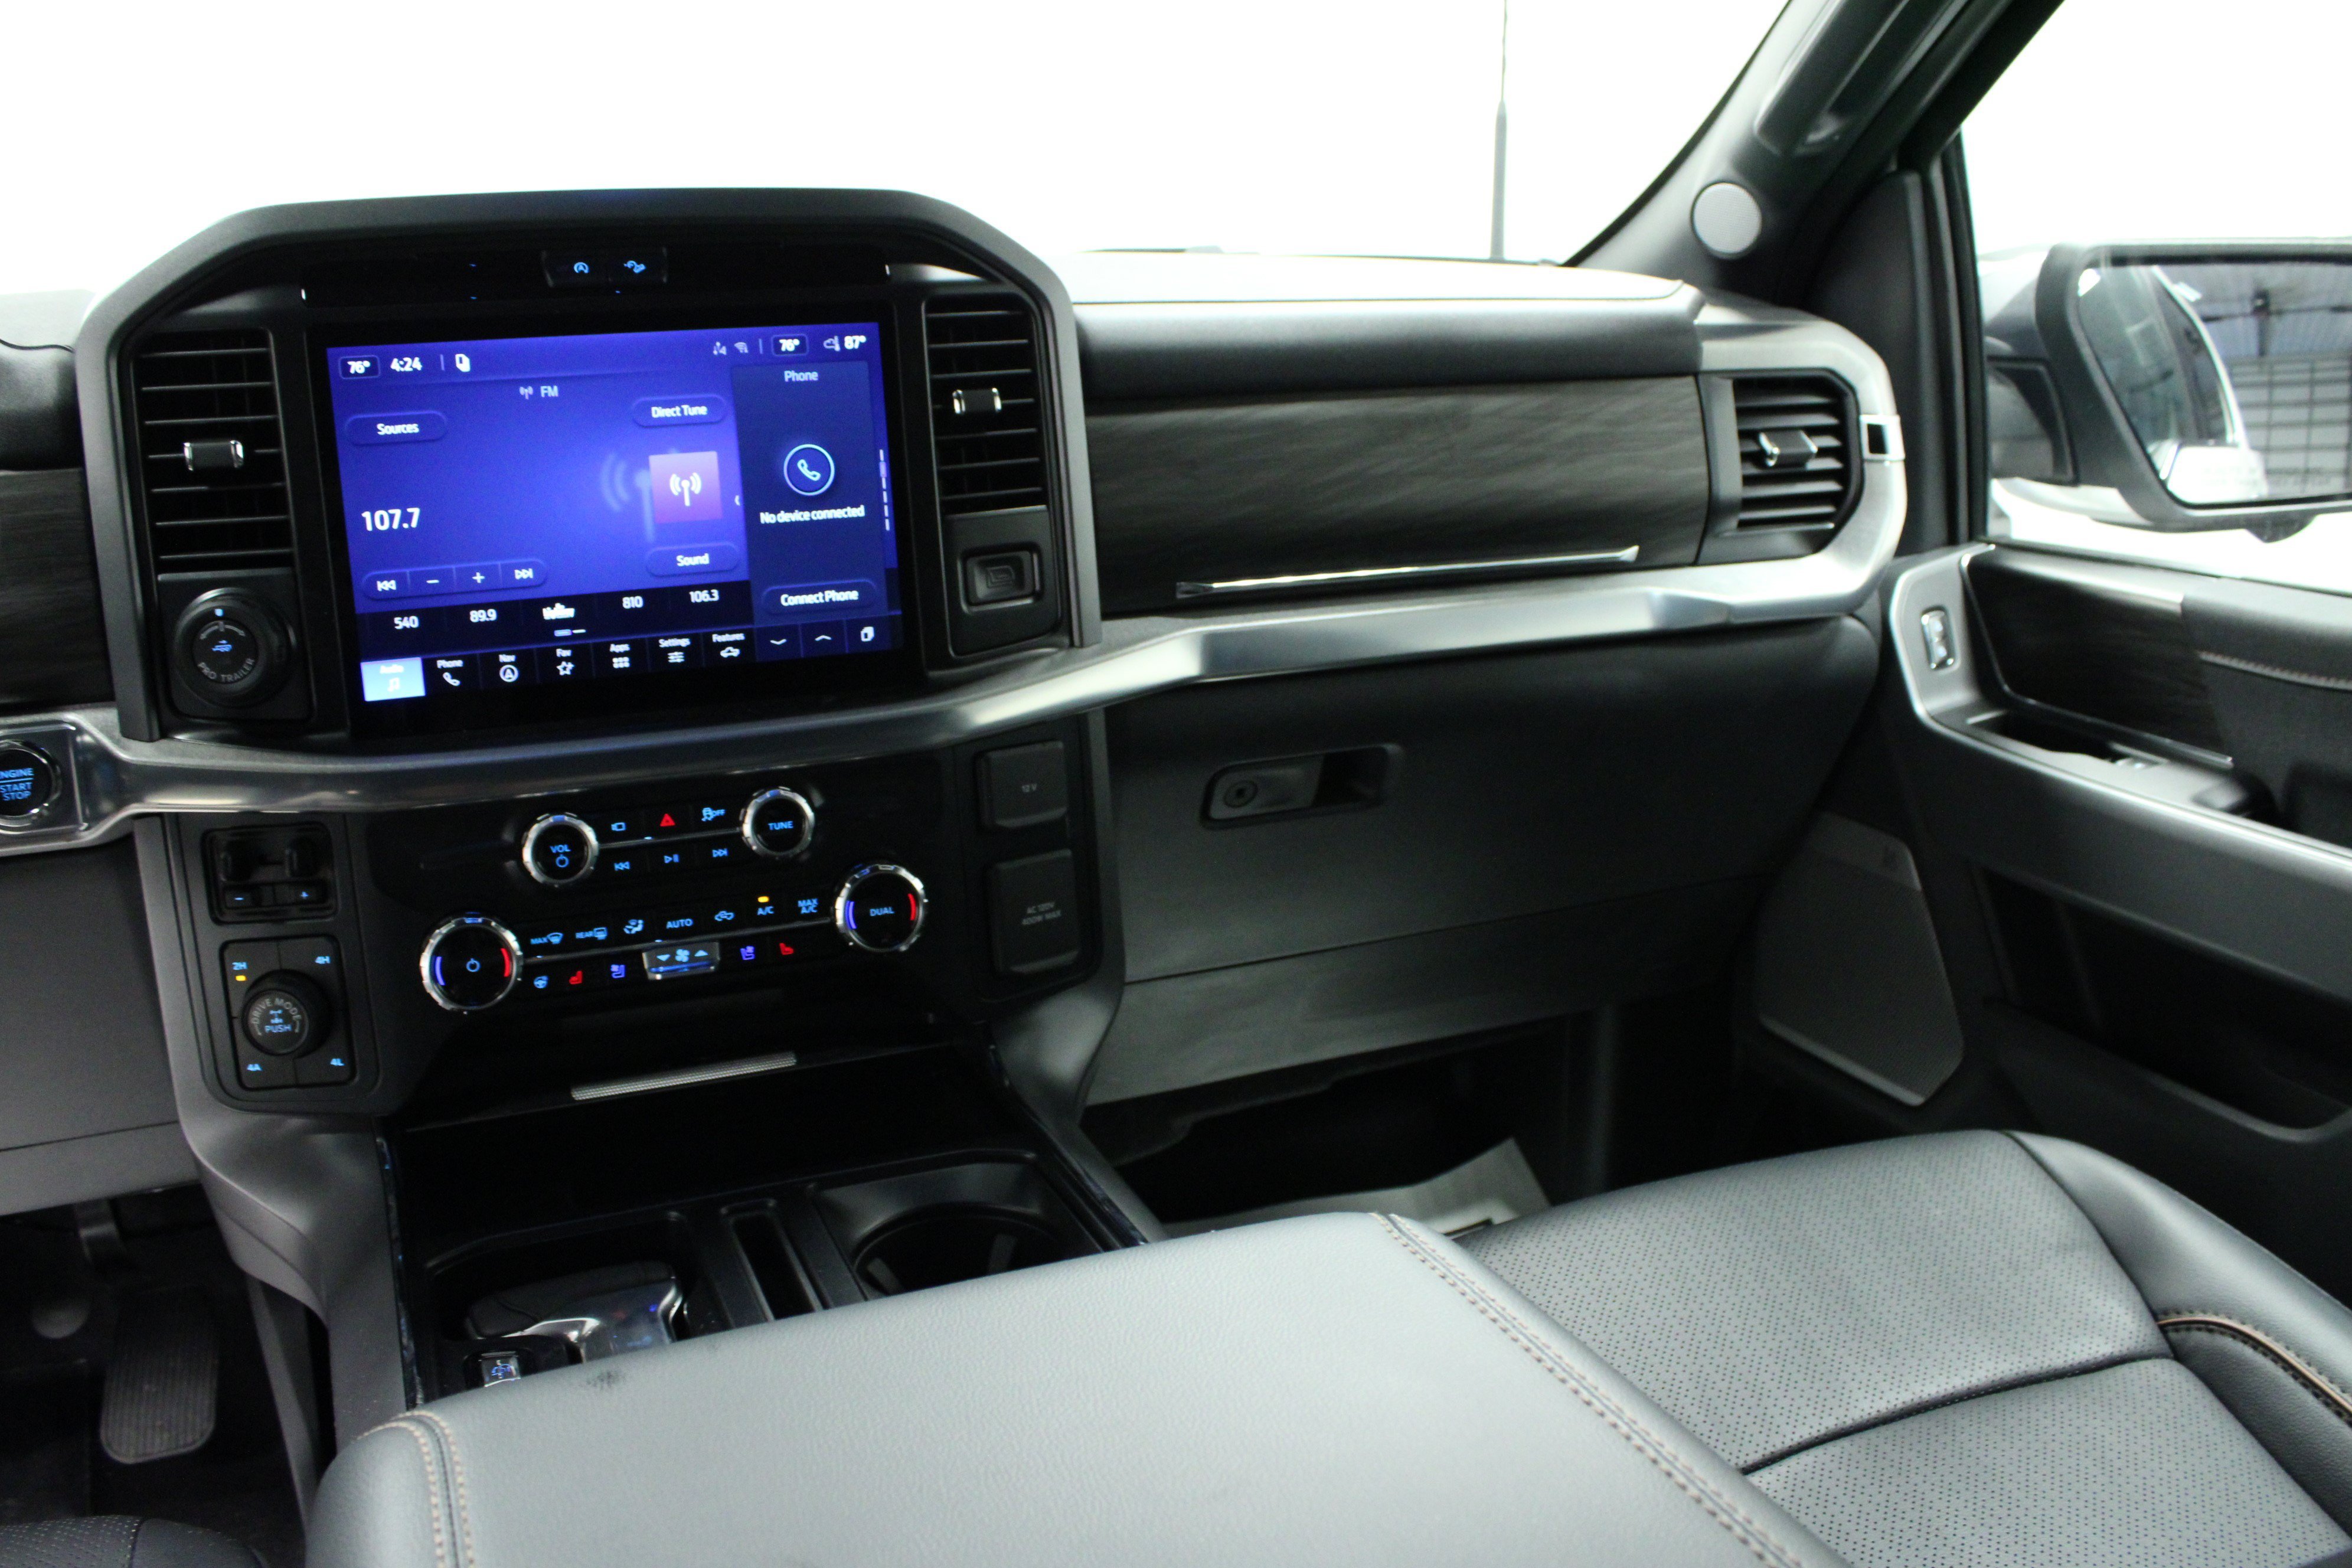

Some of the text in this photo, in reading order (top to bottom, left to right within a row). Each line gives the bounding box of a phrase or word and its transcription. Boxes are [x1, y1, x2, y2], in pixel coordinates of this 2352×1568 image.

[779, 338, 800, 352] 76°
[844, 335, 867, 350] 87°
[347, 360, 371, 374] 76°
[390, 357, 423, 372] 4:24
[784, 370, 819, 382] Phone
[540, 385, 558, 397] FM
[651, 404, 708, 419] Direct Tune
[377, 423, 420, 436] Sources
[361, 507, 420, 531] 107.7
[759, 504, 865, 524] No device connected
[676, 553, 710, 567] Sound
[689, 589, 720, 603] 106.3
[780, 590, 859, 606] Connect Phone
[622, 596, 643, 609] 810
[469, 609, 497, 623] 89.9
[394, 615, 419, 630] 540
[658, 638, 691, 648] Settings
[712, 633, 745, 642] Features
[556, 648, 571, 657] Fav
[609, 643, 631, 653] Apps
[498, 654, 516, 662] Nav
[379, 663, 405, 675] Audio
[436, 659, 463, 669] Phone
[197, 658, 255, 683] PRO TRAILER
[0, 767, 34, 779] NGINE
[0, 782, 33, 793] START
[2, 790, 31, 801] STOP
[713, 808, 726, 818] OFF
[768, 821, 793, 830] TUNE
[550, 844, 571, 854] VOL
[798, 897, 819, 908] MAX
[757, 906, 774, 916] A/C
[799, 904, 818, 915] A/C
[870, 907, 894, 916] DUAL
[666, 918, 694, 929] AUTO
[576, 930, 594, 939] REAR
[530, 936, 550, 945] MAX
[315, 956, 331, 965] 4H
[232, 962, 247, 971] 2H
[251, 998, 272, 1024] DRIVE
[264, 1024, 292, 1033] PUSH
